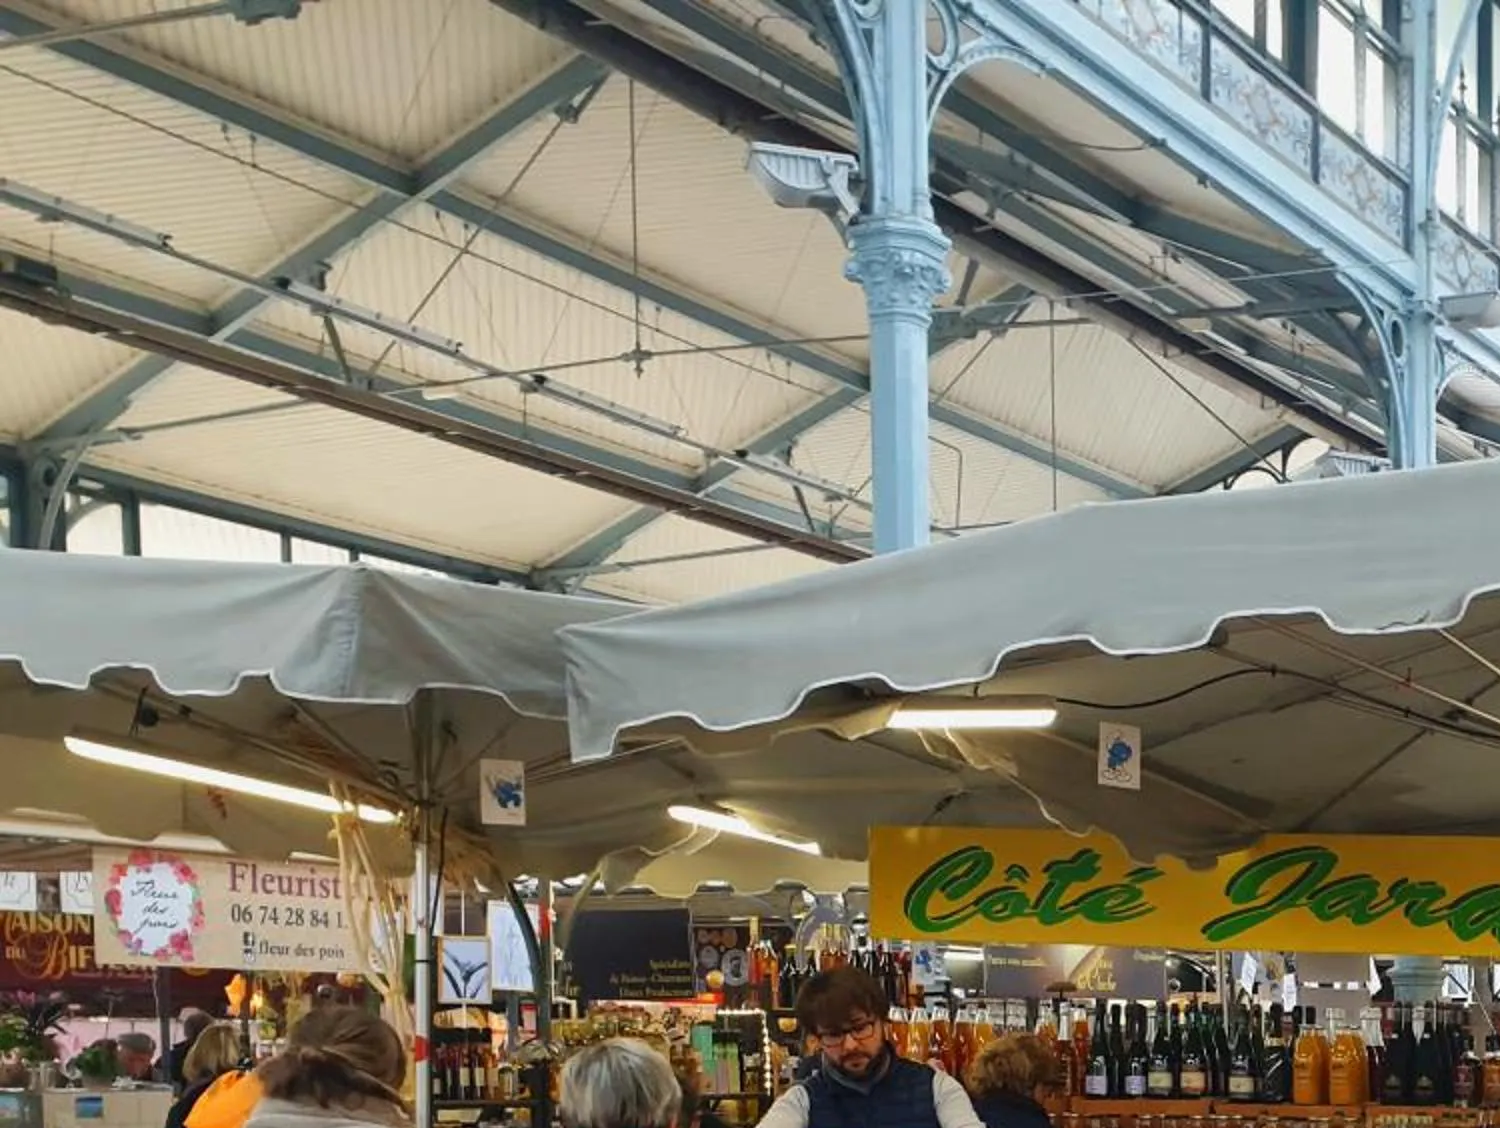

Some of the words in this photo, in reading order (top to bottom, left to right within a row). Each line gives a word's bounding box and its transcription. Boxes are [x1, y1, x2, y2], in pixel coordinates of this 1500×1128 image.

[229, 861, 343, 899] Fleurist
[904, 845, 1165, 932] Côté
[231, 904, 253, 924] 06
[259, 905, 279, 925] 74
[285, 907, 305, 927] 28
[310, 908, 329, 929] 84
[336, 911, 349, 929] 1
[259, 939, 289, 956] fleur
[319, 945, 345, 960] pois
